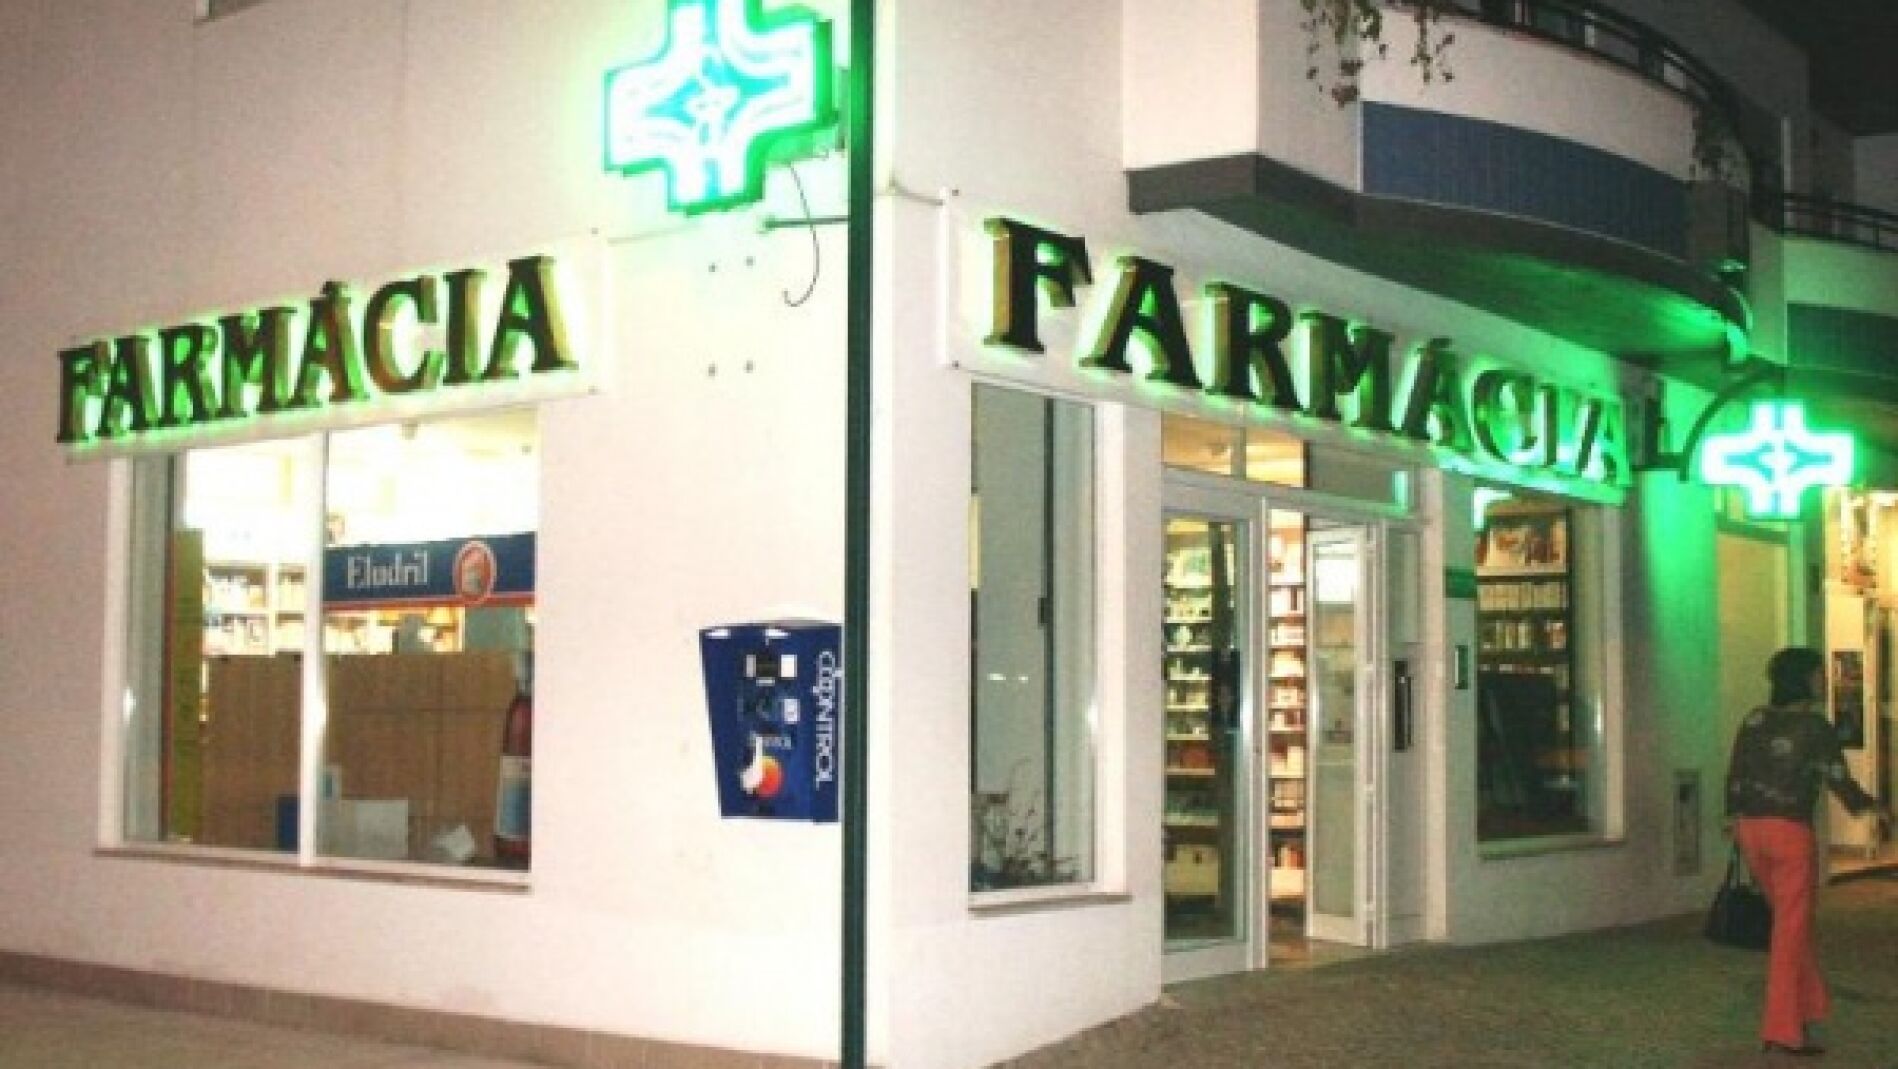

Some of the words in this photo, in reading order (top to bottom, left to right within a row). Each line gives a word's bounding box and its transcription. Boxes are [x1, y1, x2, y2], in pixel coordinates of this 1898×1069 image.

[55, 253, 579, 444] FARMÁCIA
[982, 216, 1629, 488] FARMÁCIA
[346, 550, 430, 589] Eludril
